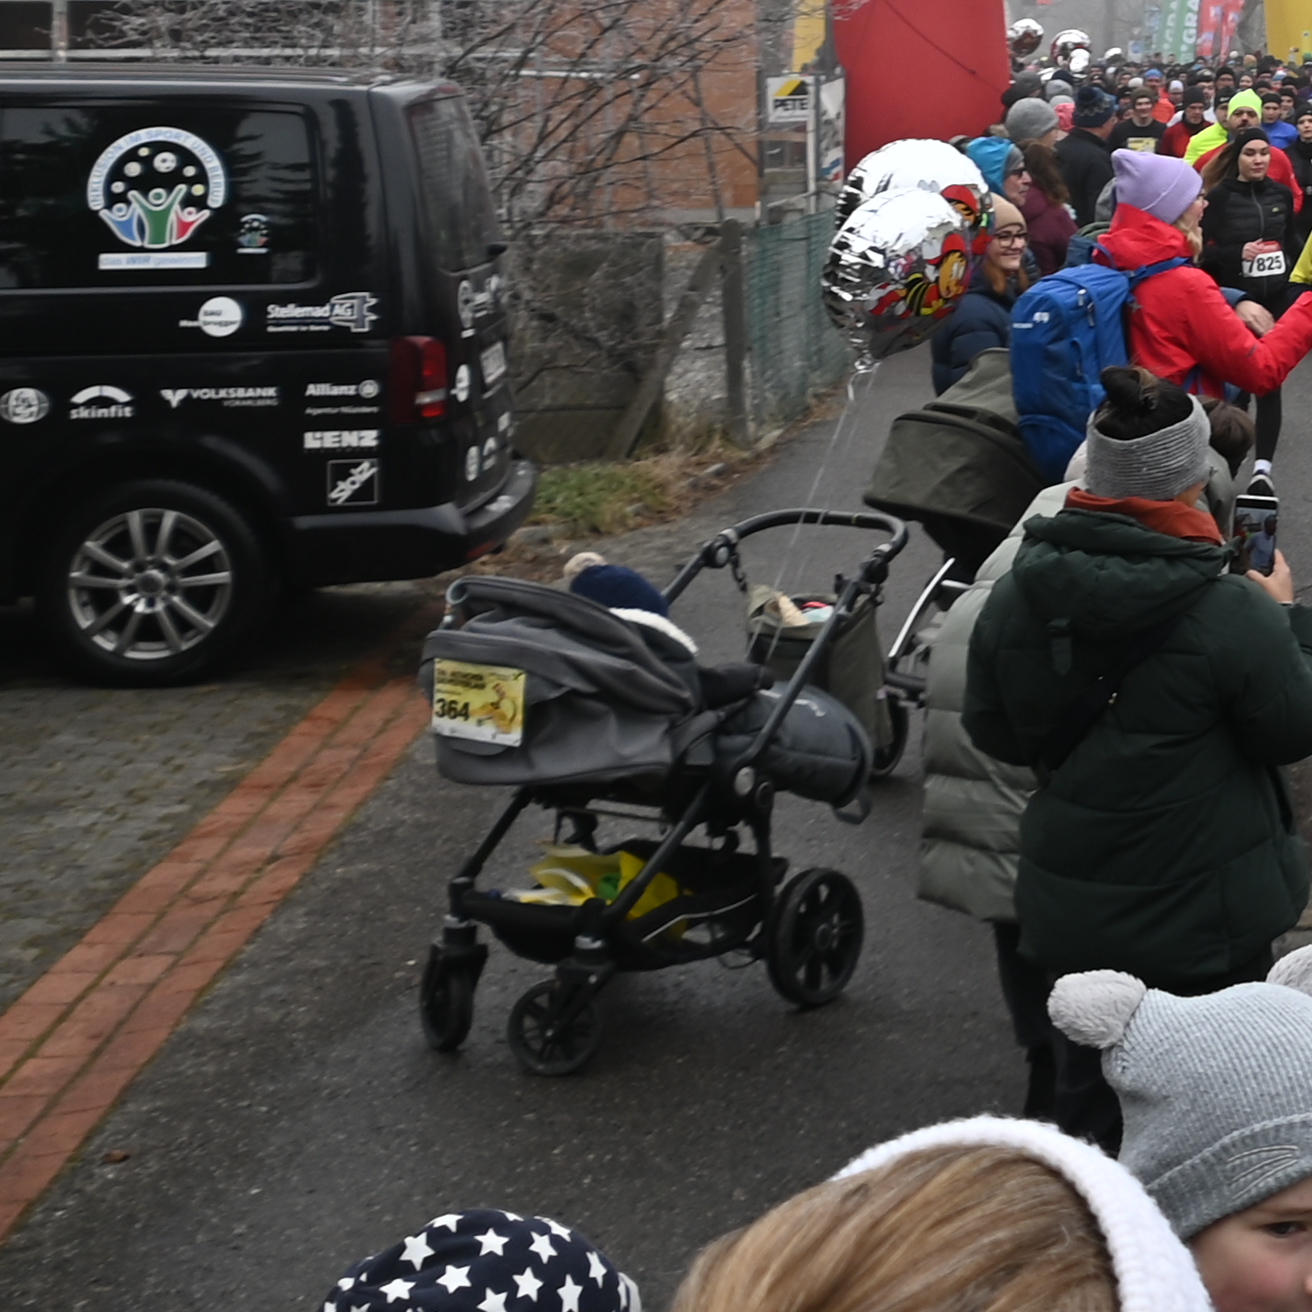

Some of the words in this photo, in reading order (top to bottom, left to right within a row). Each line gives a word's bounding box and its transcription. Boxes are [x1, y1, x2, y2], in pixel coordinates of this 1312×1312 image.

[145, 129, 188, 145] SPORT
[190, 387, 279, 400] VOLKSBANK
[304, 382, 358, 397] Allianz
[69, 405, 135, 420] skinfit
[435, 697, 470, 722] 364
